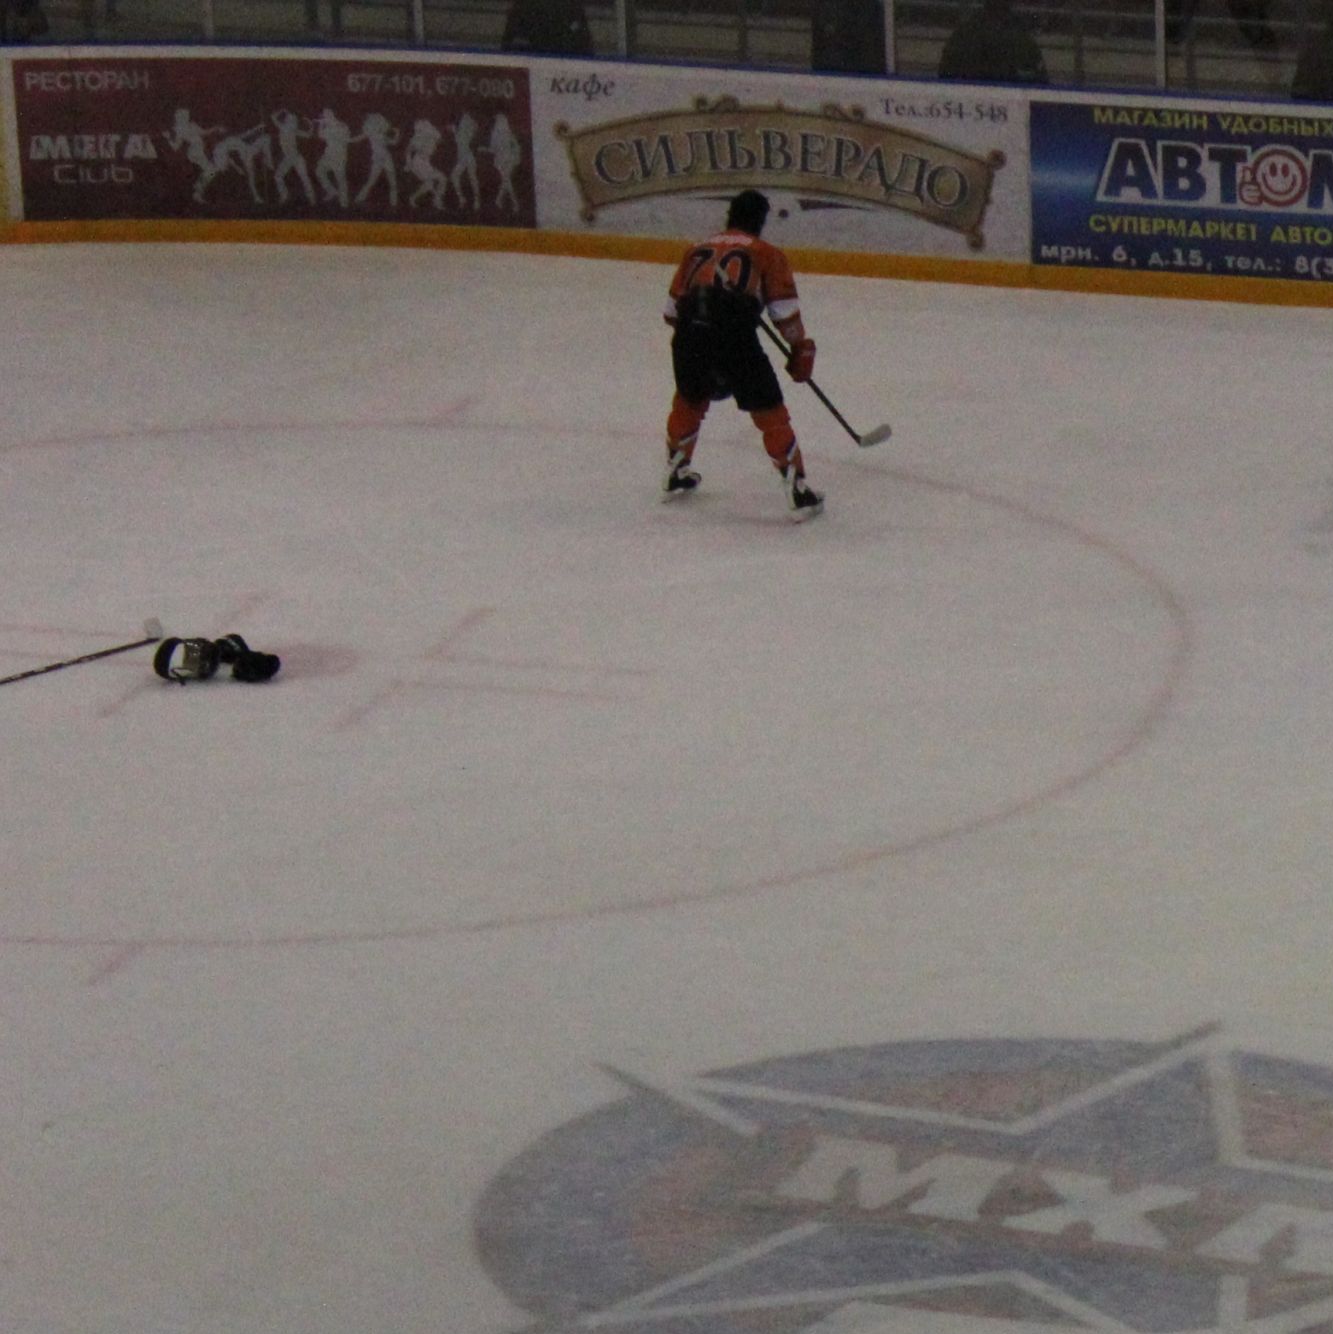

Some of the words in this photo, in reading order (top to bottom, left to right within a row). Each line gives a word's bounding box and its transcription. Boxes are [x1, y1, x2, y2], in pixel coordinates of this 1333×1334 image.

[24, 71, 150, 92] РЕСТОРАН
[550, 75, 616, 100] кафе
[1093, 108, 1208, 131] МАГАЗИН
[52, 163, 134, 184] Club
[593, 127, 970, 208] СИЛЬВЕРАДО
[1089, 215, 1258, 242] СУПЕРМАРКЕТ
